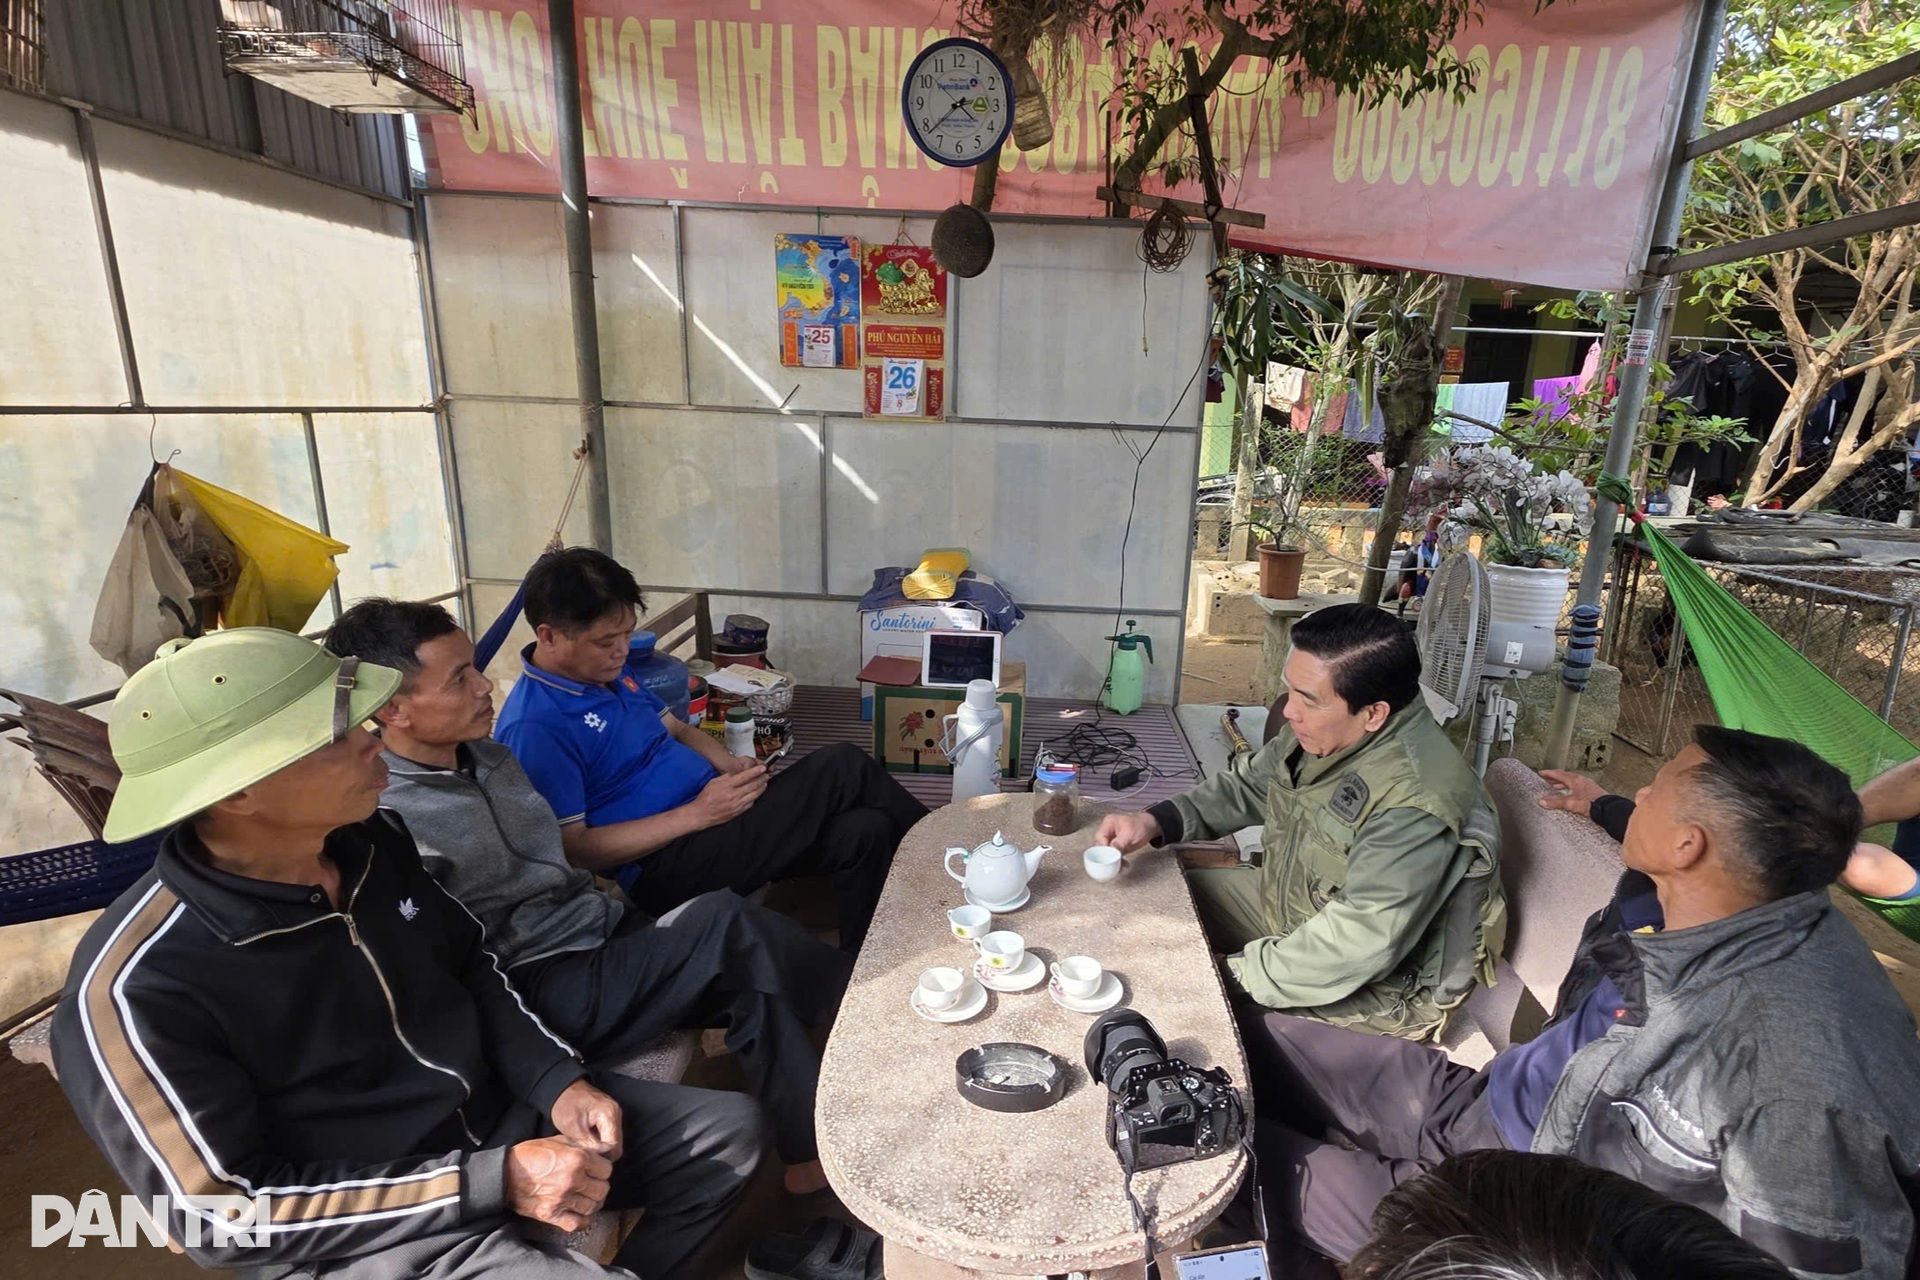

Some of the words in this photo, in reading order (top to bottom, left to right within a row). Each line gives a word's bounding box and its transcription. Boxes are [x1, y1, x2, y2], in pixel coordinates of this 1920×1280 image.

[934, 59, 944, 73] 11
[952, 53, 966, 68] 12
[975, 60, 981, 75] 1
[920, 74, 933, 89] 10
[987, 76, 996, 91] 2
[916, 96, 925, 111] 9
[992, 98, 1000, 113] 3
[922, 117, 931, 132] 8
[986, 119, 995, 134] 4
[935, 134, 944, 149] 7
[955, 140, 964, 154] 6
[974, 134, 982, 149] 5
[811, 329, 831, 344] 25
[867, 330, 886, 342] PHÚ
[888, 366, 916, 389] 26
[870, 609, 937, 632] Santorini
